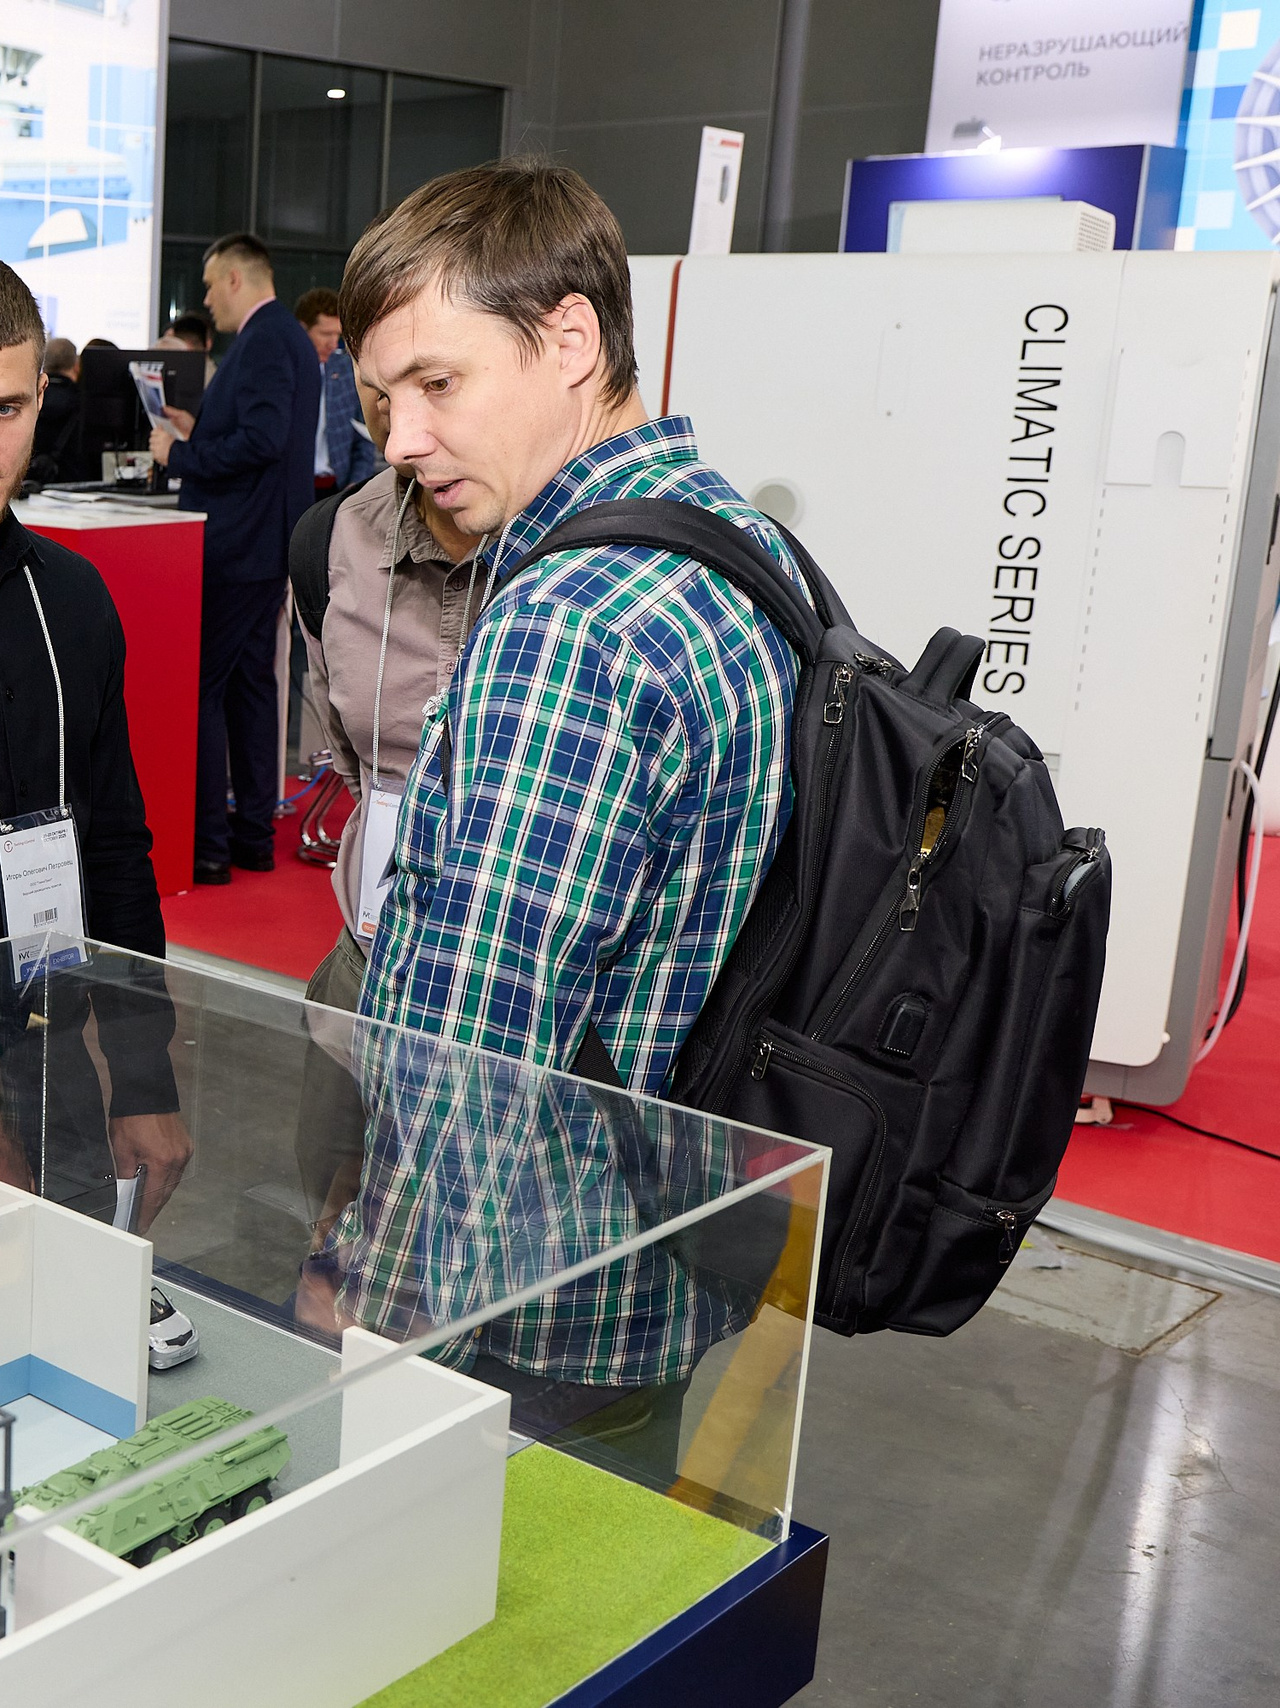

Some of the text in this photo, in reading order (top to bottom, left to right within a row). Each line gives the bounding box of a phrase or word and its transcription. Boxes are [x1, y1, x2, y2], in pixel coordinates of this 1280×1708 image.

[978, 22, 1188, 62] НЕРАЗРУШАЮЩИЙ
[976, 61, 1091, 87] КОНТРОЛЬ
[982, 304, 1069, 695] CLIMATIC SERIES
